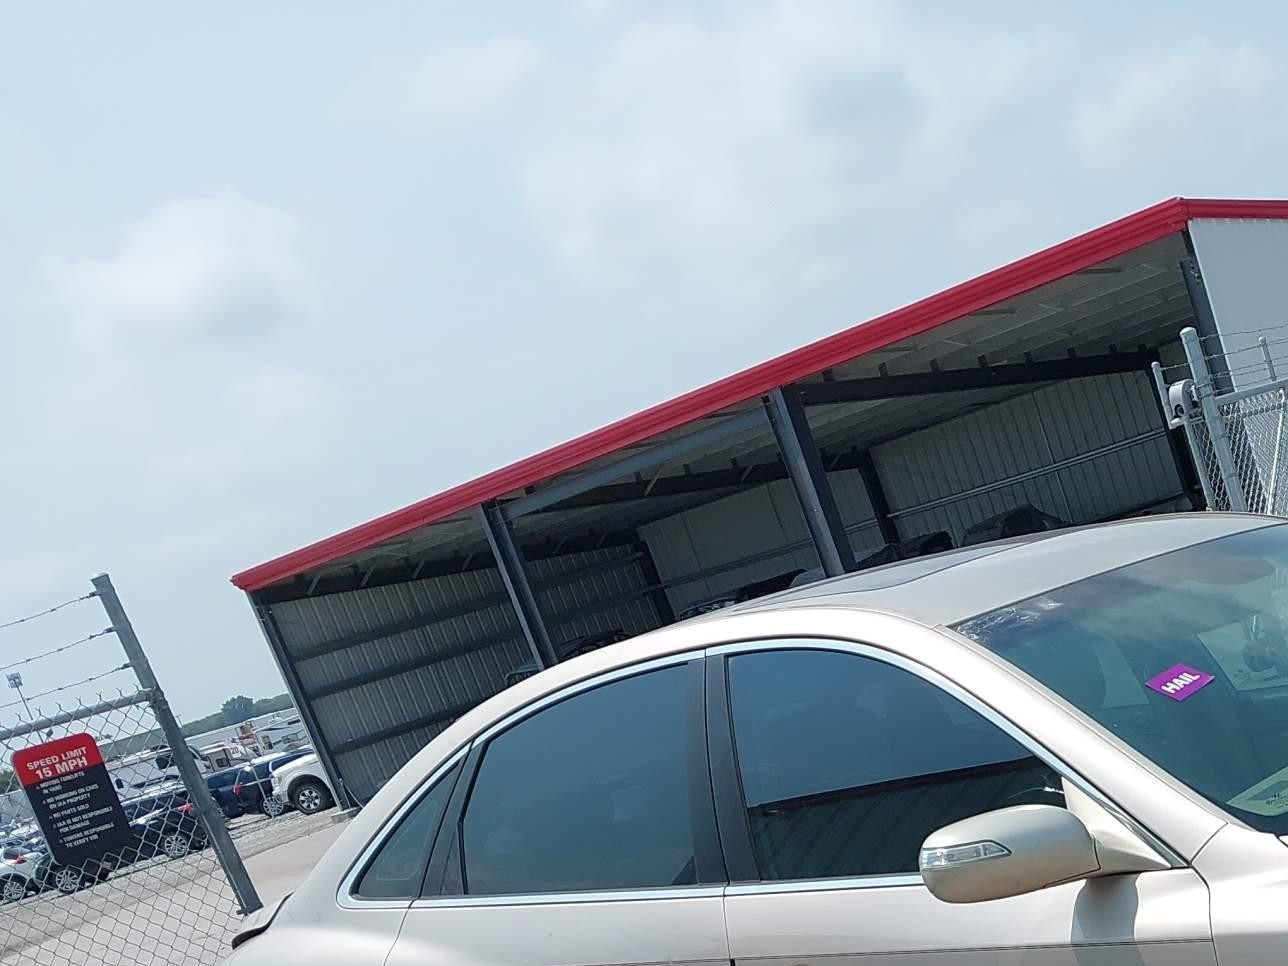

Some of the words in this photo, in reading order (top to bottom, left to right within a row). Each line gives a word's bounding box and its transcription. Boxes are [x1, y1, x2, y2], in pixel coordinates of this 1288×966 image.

[1161, 673, 1200, 693] HAIL
[26, 755, 59, 770] SPEED
[61, 746, 87, 760] LIMIT
[35, 766, 52, 779] 15
[55, 756, 88, 774] MPH
[66, 792, 90, 803] PROPERTY
[61, 807, 77, 816] PARTS
[76, 803, 90, 811] SOLD
[82, 806, 112, 819] RESPONSIBLE
[83, 821, 114, 835] RESPONSIBLE
